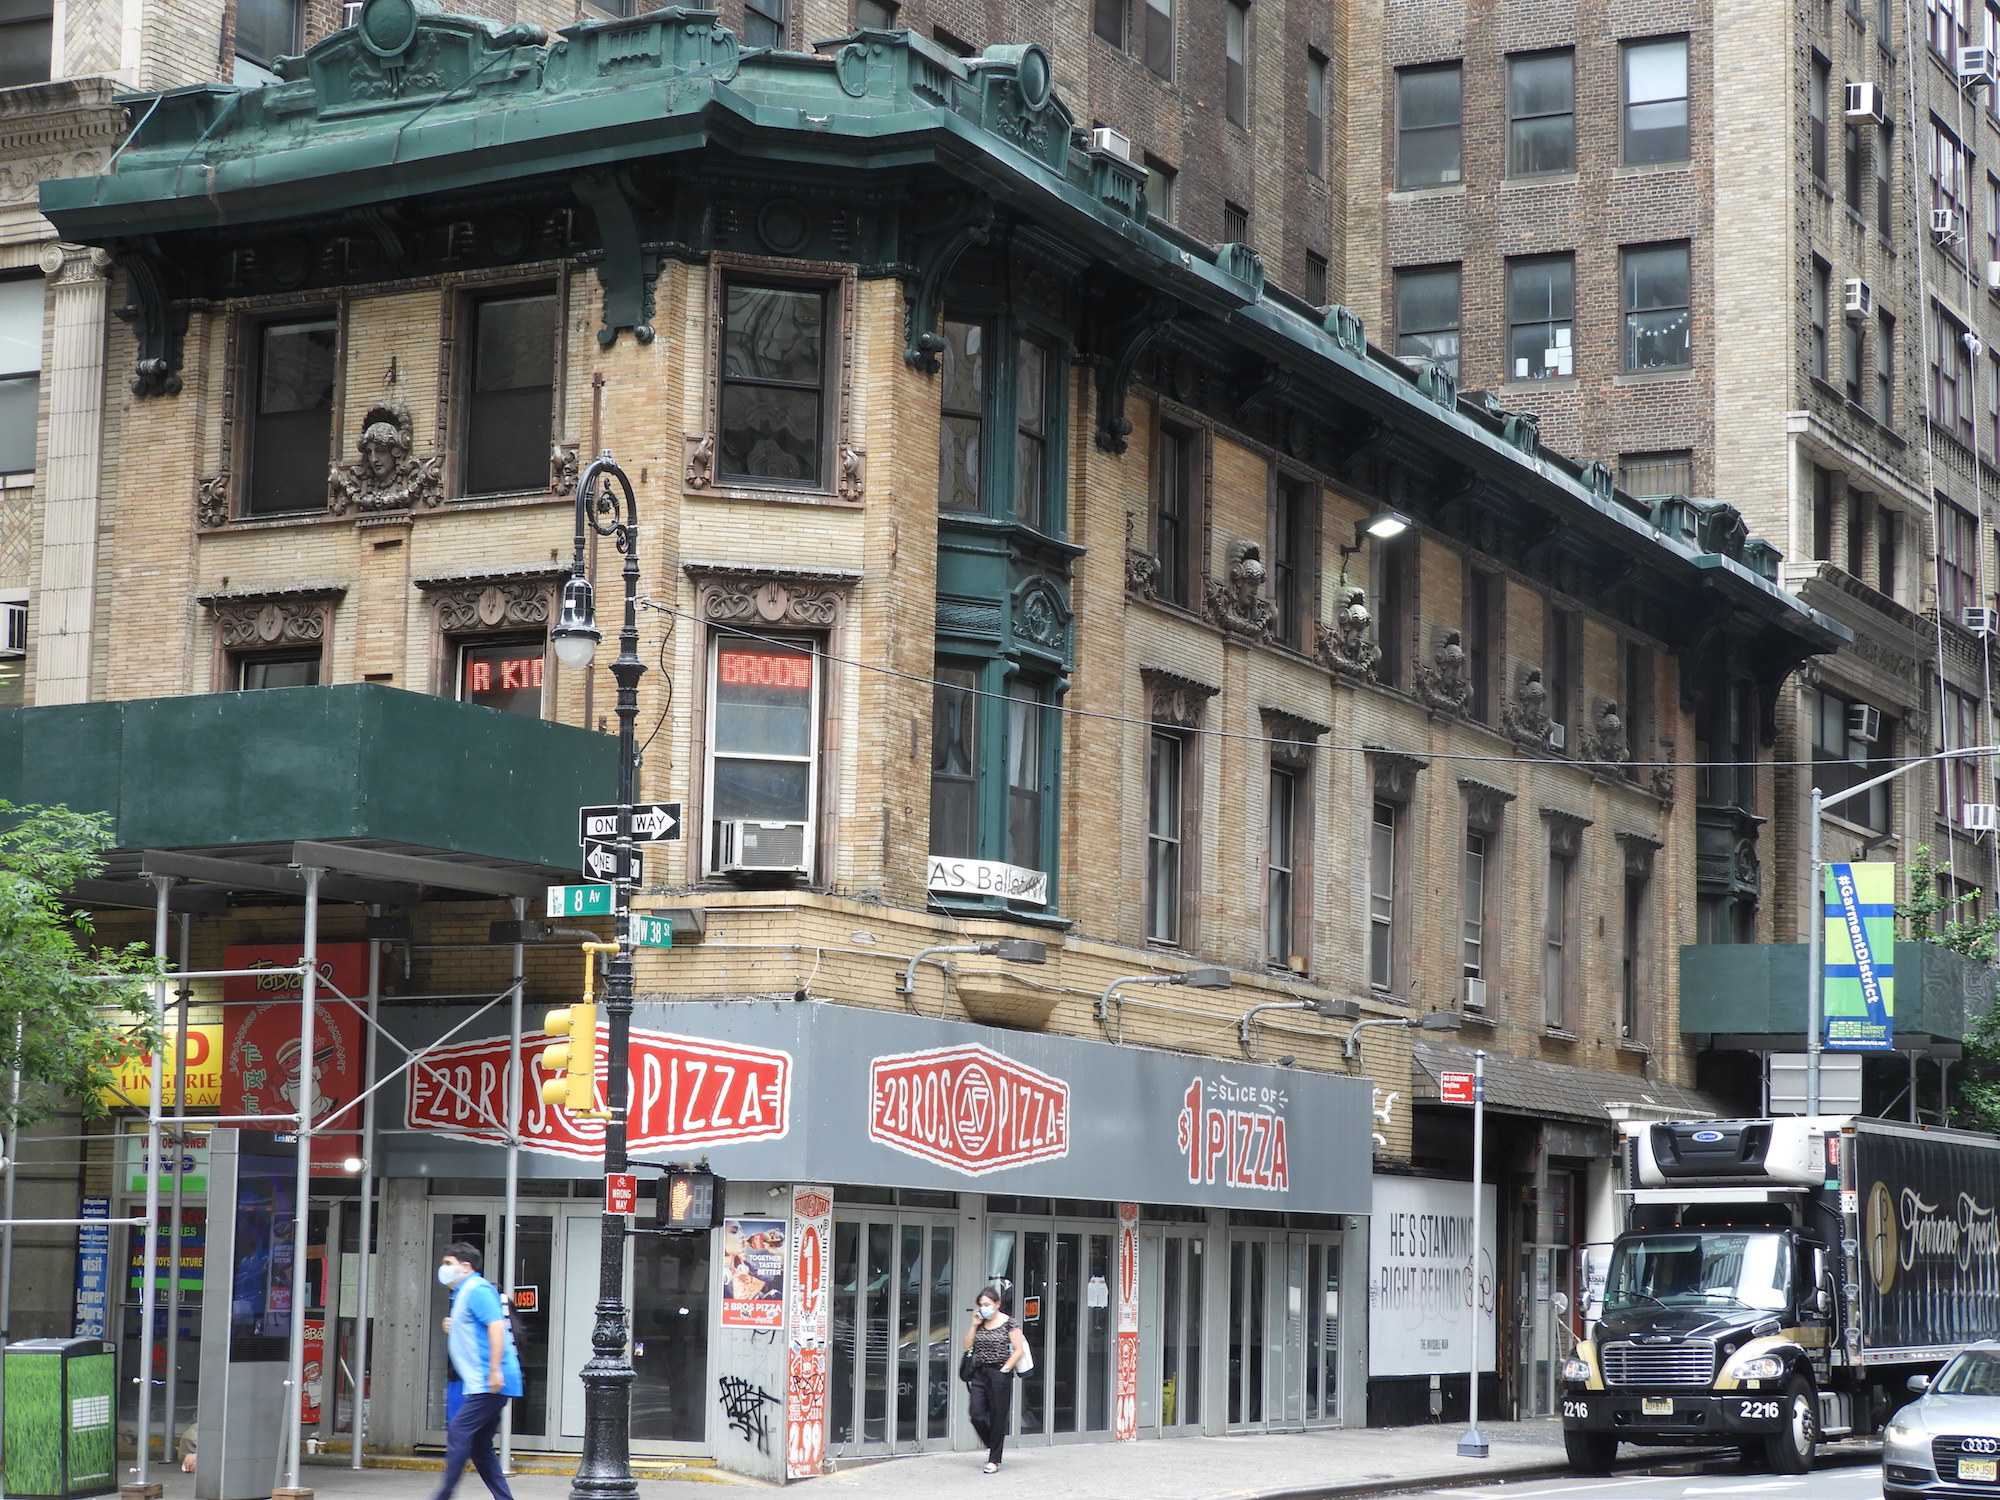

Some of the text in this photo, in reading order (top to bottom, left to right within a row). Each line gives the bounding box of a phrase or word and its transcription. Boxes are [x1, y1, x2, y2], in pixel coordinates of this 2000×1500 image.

[636, 815, 665, 831] WAY
[594, 853, 610, 870] ONE
[929, 862, 965, 887] AS
[574, 889, 600, 912] 8 Av
[640, 919, 671, 944] W 38 St
[1838, 875, 1879, 1004] #GarmentDistrict
[320, 963, 333, 988] 2
[121, 1072, 223, 1089] LINGRIE
[197, 1093, 222, 1105] AV
[641, 1053, 763, 1135] PIZZA
[1219, 1085, 1277, 1103] SLICE OF
[998, 1076, 1058, 1153] PIZZA
[183, 1138, 207, 1149] OWER
[274, 1134, 298, 1143] LinkNYC
[1206, 1109, 1289, 1192] PIZZA
[612, 1189, 632, 1199] WRONG
[615, 1200, 629, 1210] WAY
[1390, 1213, 1416, 1257] HE'S
[1900, 1187, 2000, 1271] Ferraro Foods
[82, 1257, 103, 1271] visit
[749, 1254, 782, 1262] TOGETHER
[83, 1275, 100, 1288] our
[1381, 1267, 1416, 1311] RIGHT
[1420, 1268, 1461, 1311] BEHIND
[77, 1288, 105, 1304] Lower
[514, 1291, 535, 1307] LOSED
[76, 1304, 103, 1320] Store
[723, 1302, 782, 1313] 2 BROS PIZZA
[1563, 1402, 1588, 1418] 2216
[1740, 1401, 1779, 1418] 2216
